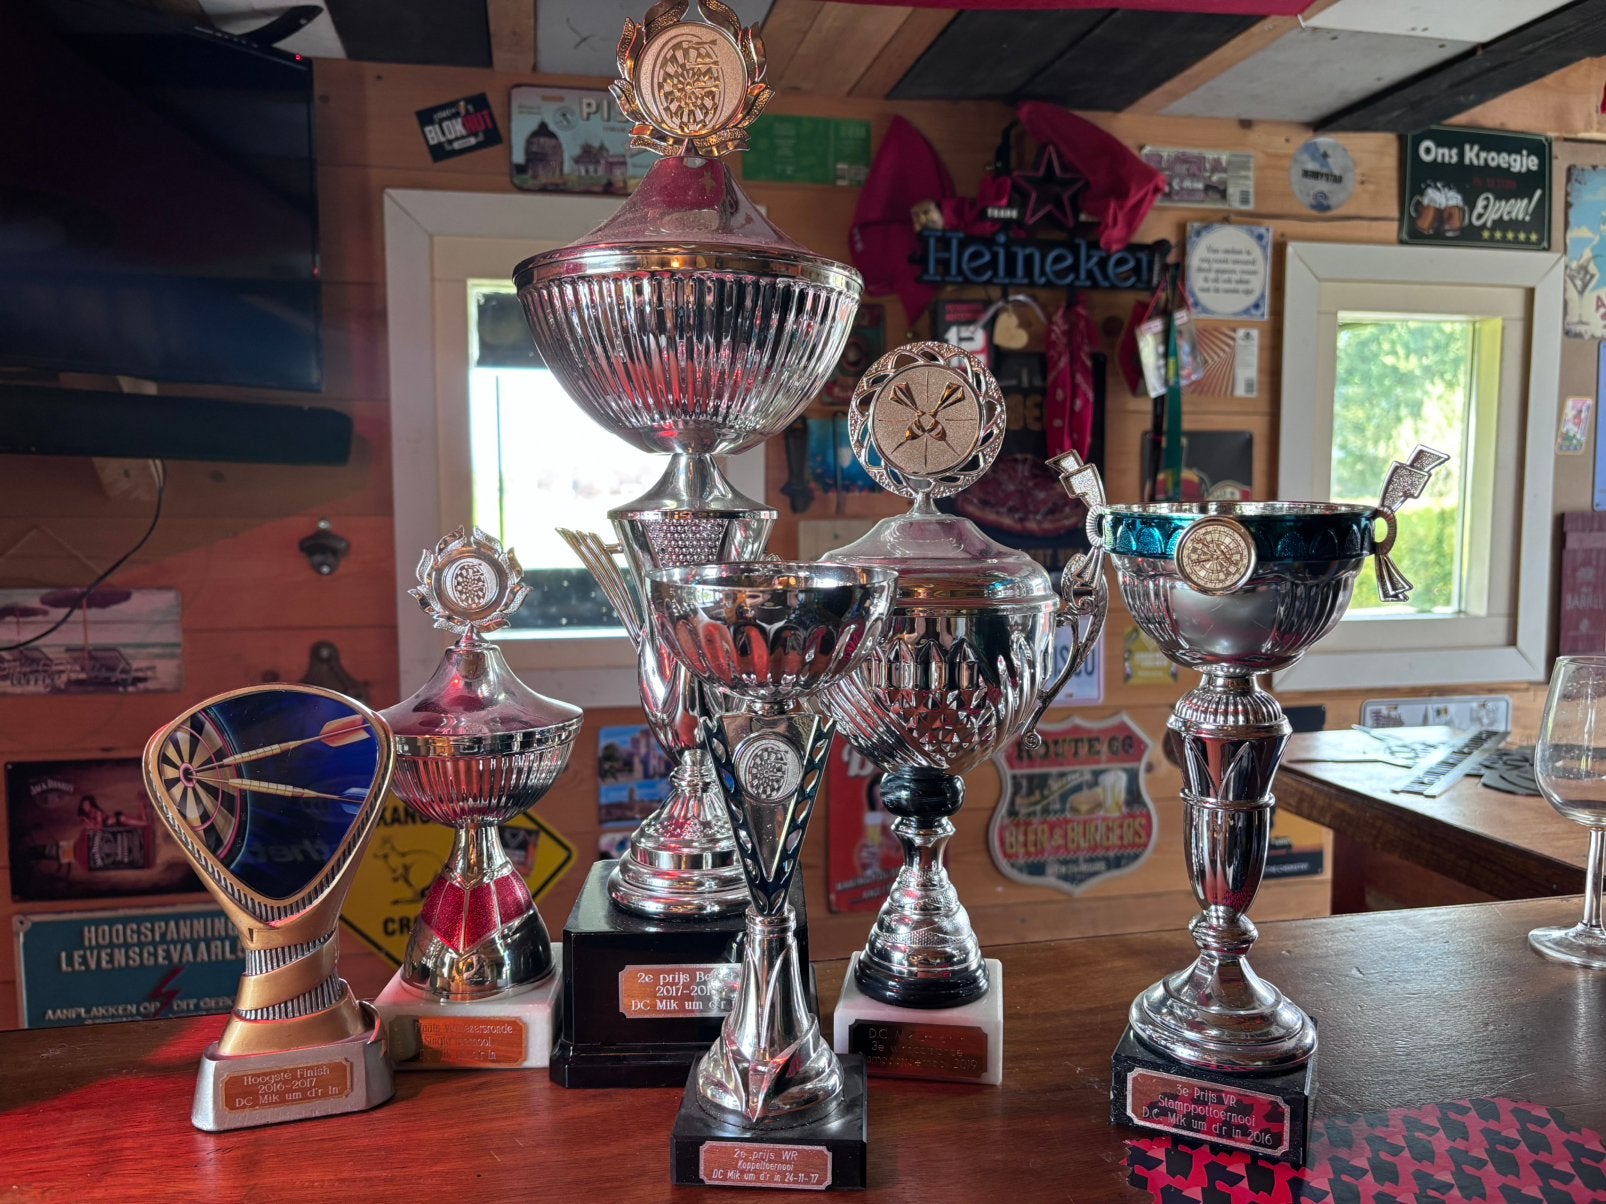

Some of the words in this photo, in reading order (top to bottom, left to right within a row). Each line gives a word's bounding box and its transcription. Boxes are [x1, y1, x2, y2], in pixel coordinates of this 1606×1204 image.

[1418, 139, 1458, 164] Ons
[1464, 143, 1539, 173] Kroegje
[1471, 188, 1542, 228] Open!
[1108, 736, 1134, 755] 66
[1004, 823, 1049, 854] BEER
[1066, 818, 1147, 850] BURGERS
[383, 916, 418, 937] CR
[637, 972, 654, 983] 2e
[660, 972, 690, 985] prijs
[45, 1003, 137, 1021] AANPLAKKEN
[140, 1001, 161, 1014] OP
[631, 1000, 650, 1011] DC
[656, 1000, 679, 1010] Mik
[685, 1001, 704, 1010] um
[869, 1028, 888, 1039] DC
[872, 1041, 884, 1051] 3e
[244, 1071, 292, 1086] Hoogste
[297, 1066, 330, 1079] Finish
[258, 1078, 316, 1094] 2016-2017
[235, 1096, 254, 1108] DC
[259, 1094, 280, 1105] Mik
[285, 1091, 302, 1100] um
[1176, 1084, 1189, 1097] 3e
[1194, 1088, 1217, 1104] Prijs
[1222, 1094, 1237, 1107] VR
[1168, 1111, 1187, 1127] Mik
[1192, 1119, 1206, 1131] um
[1212, 1121, 1227, 1135] d'r
[1232, 1126, 1241, 1138] in
[1248, 1129, 1272, 1145] 2016
[734, 1148, 746, 1159] 2e
[751, 1150, 775, 1162] prijs
[782, 1151, 798, 1160] WR
[712, 1168, 723, 1179] DC
[726, 1170, 741, 1179] Mik
[737, 1159, 794, 1171] Koppeltoernooi
